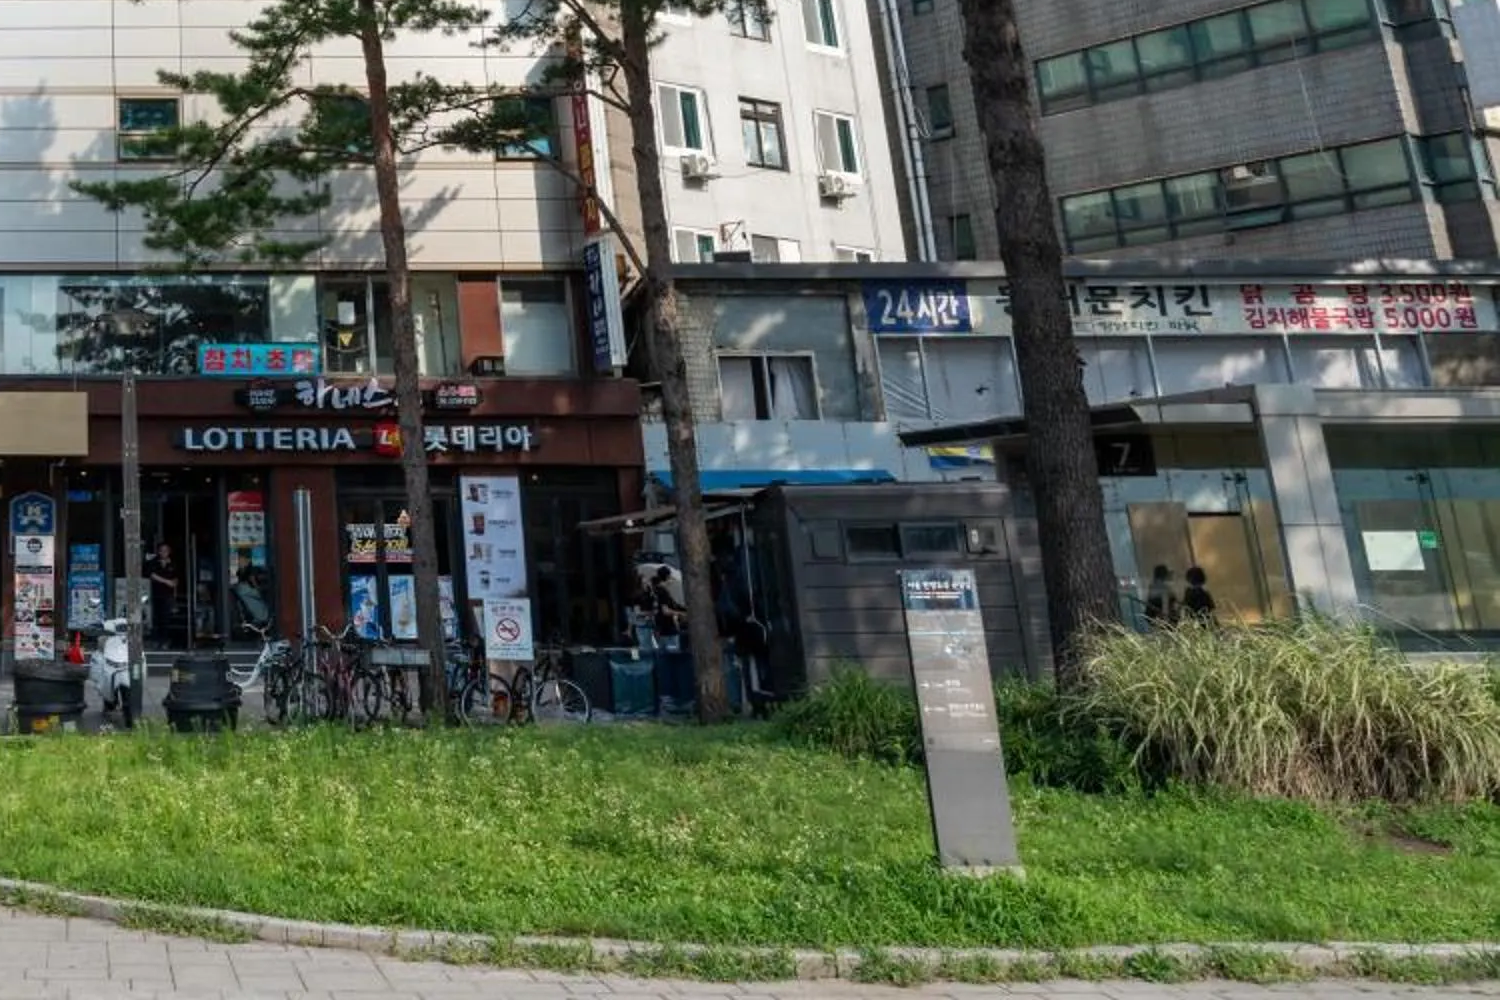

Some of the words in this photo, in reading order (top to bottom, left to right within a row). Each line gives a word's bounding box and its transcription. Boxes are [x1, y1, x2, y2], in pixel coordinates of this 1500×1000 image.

[877, 289, 961, 327] 24시간
[1244, 307, 1375, 330] 김치해물국밥
[294, 377, 423, 409] 하네스
[184, 428, 356, 450] LOTTERIA
[423, 425, 533, 452] 롯데리아
[1111, 443, 1131, 466] 7
